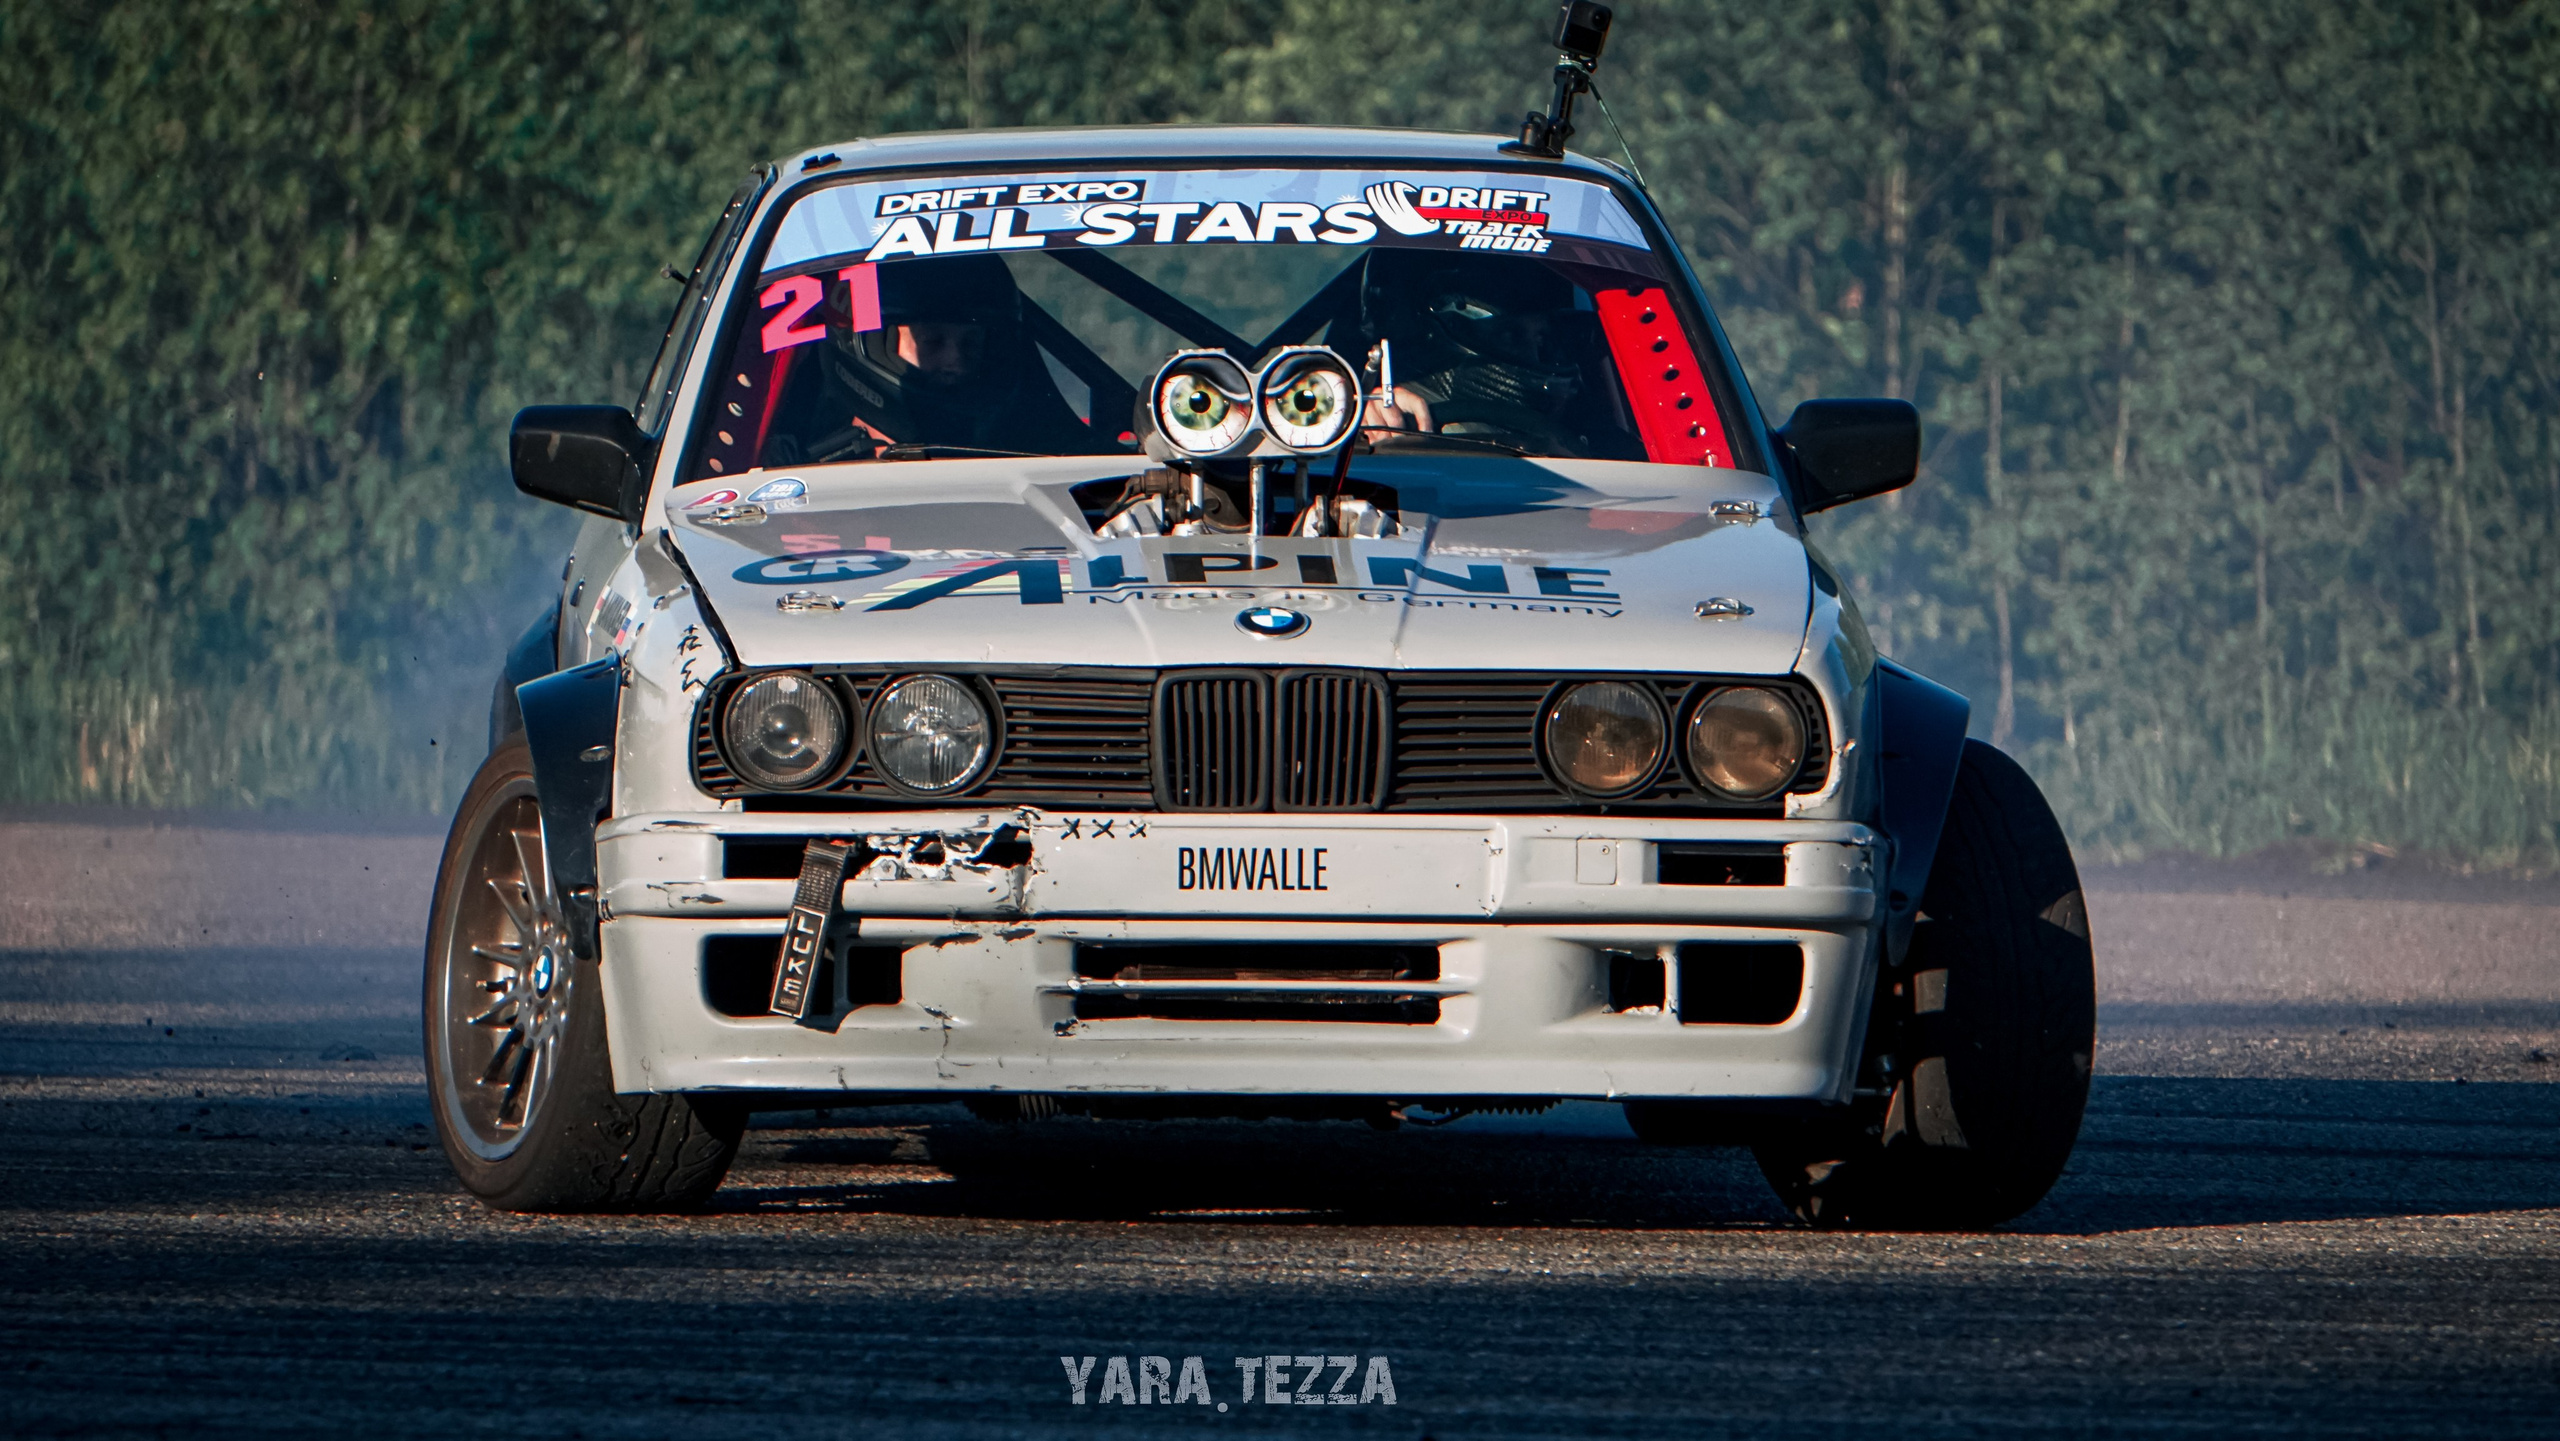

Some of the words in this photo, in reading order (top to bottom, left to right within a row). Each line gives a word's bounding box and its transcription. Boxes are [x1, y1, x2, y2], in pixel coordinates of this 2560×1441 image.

[880, 185, 1009, 216] DRIFT
[1017, 180, 1139, 204] EXPO
[1419, 186, 1548, 213] DRIFT
[864, 208, 1047, 262] ALL
[1075, 201, 1379, 246] STARS
[1444, 219, 1545, 239] TRACK
[1481, 209, 1533, 222] EXPO
[1459, 234, 1553, 253] MODE
[759, 261, 882, 354] 21
[862, 552, 1620, 613] ALPINE
[1089, 590, 1255, 604] Made
[1357, 592, 1624, 618] Germany
[1177, 847, 1329, 891] BMWALLE
